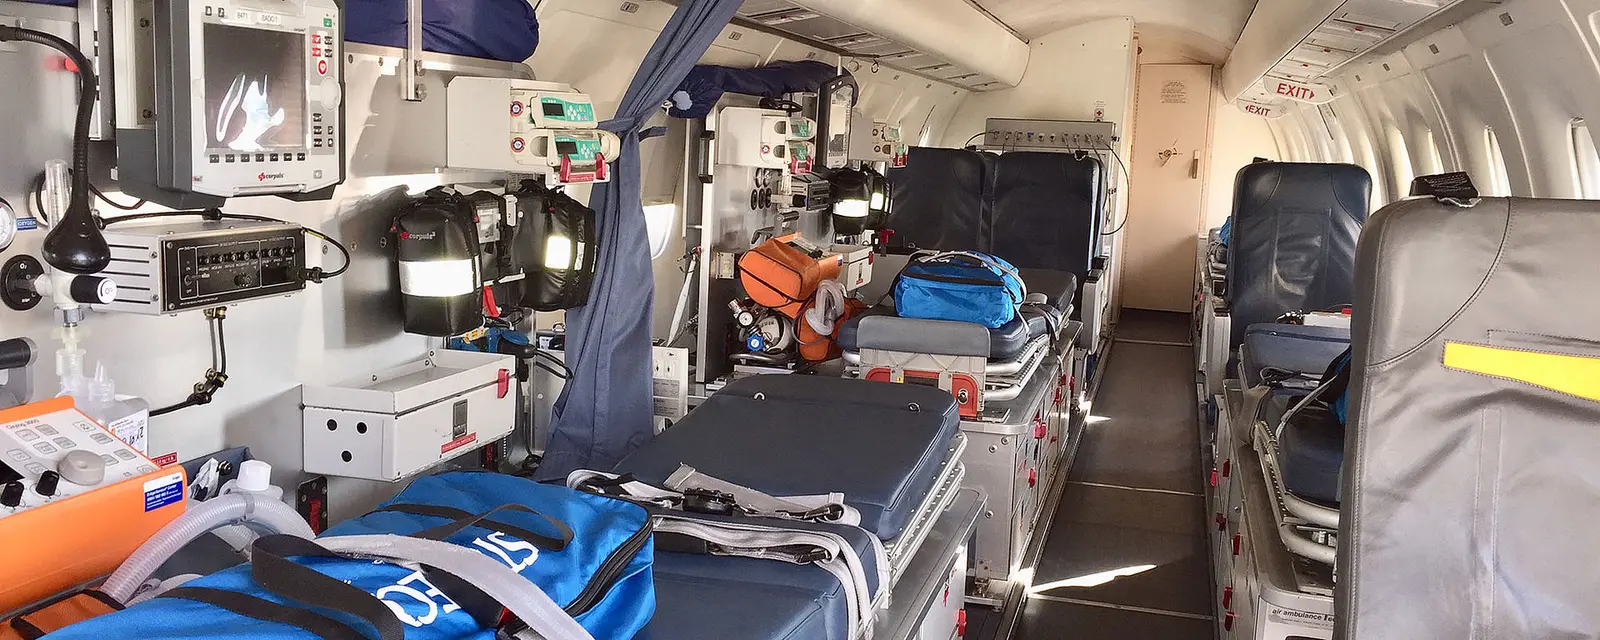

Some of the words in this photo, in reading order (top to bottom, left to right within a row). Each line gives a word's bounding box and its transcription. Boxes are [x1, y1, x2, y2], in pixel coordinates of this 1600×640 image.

[1276, 83, 1310, 99] EXIT
[1248, 104, 1271, 116] EXIT
[1283, 611, 1322, 620] ambulance
